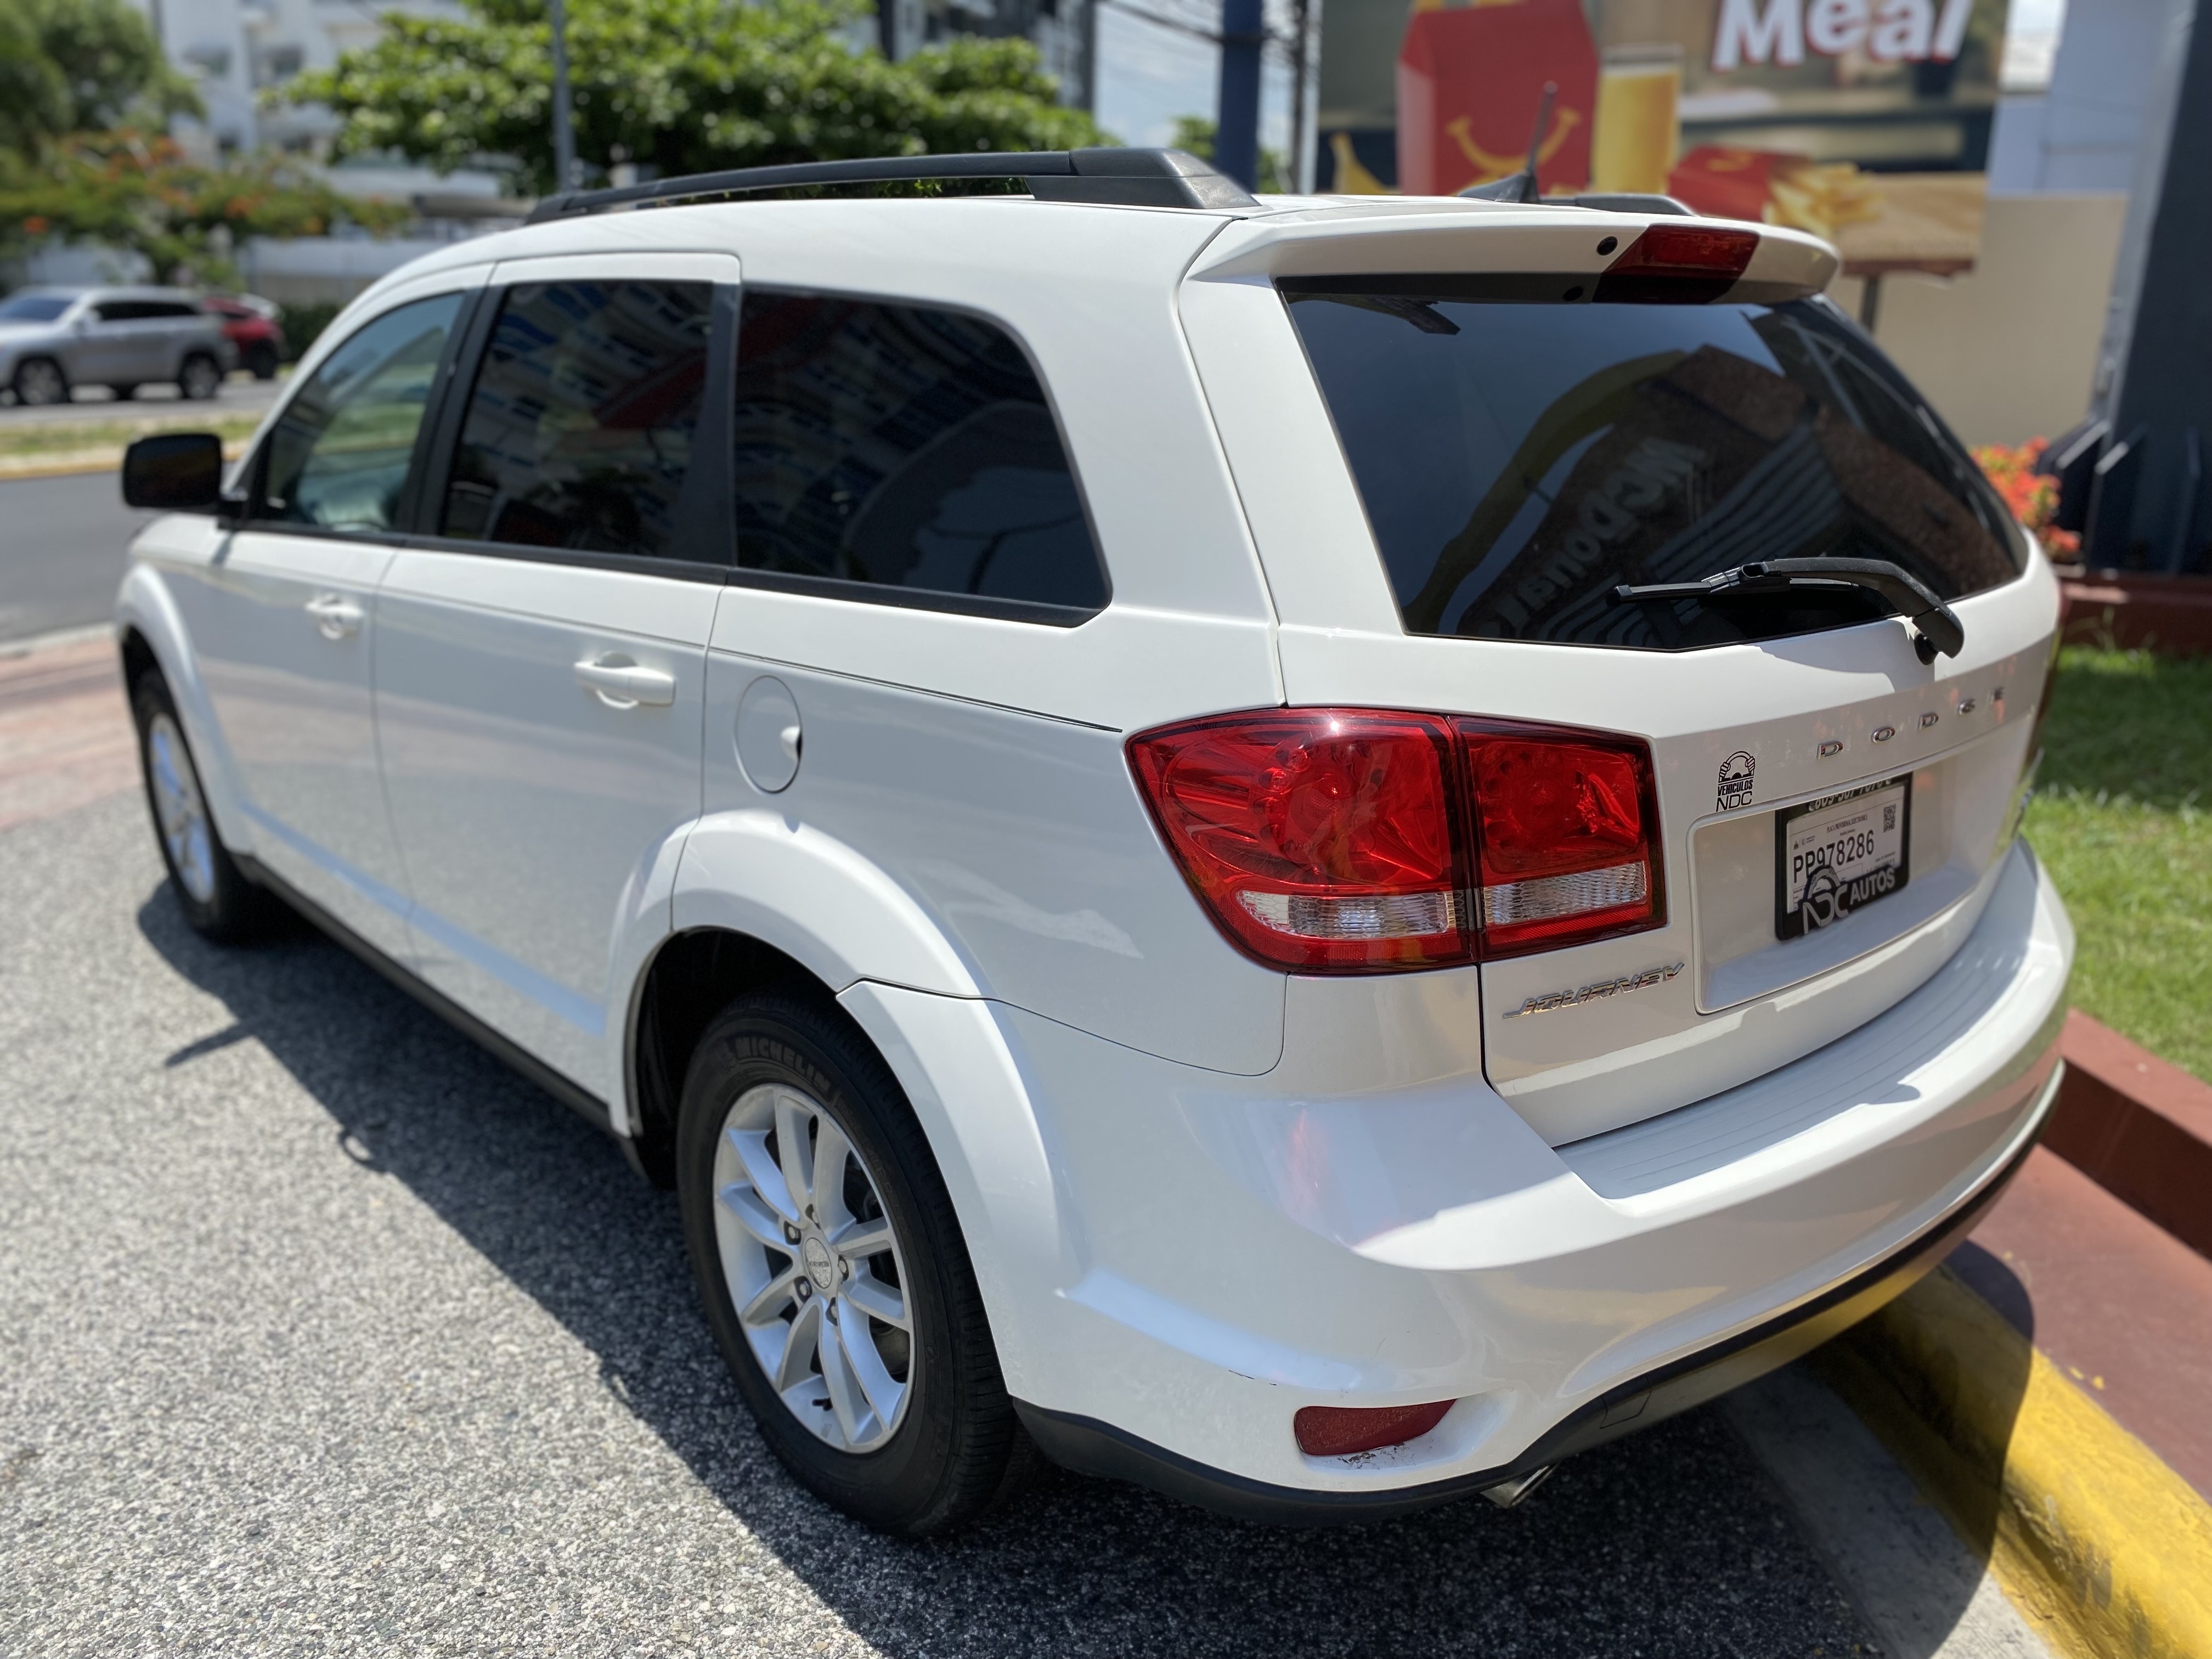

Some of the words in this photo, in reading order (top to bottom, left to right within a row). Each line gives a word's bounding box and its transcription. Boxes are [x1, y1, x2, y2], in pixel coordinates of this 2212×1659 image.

[1711, 0, 1973, 71] Meal
[1817, 687, 2004, 760] DODGE
[1716, 791, 1752, 812] NDC
[1718, 779, 1753, 797] VEHICULOS
[1793, 830, 1874, 883] PP978286
[1850, 867, 1895, 905] AUTOS
[1502, 962, 1685, 1019] JOURNEY
[736, 1036, 830, 1092] MICHELIN
